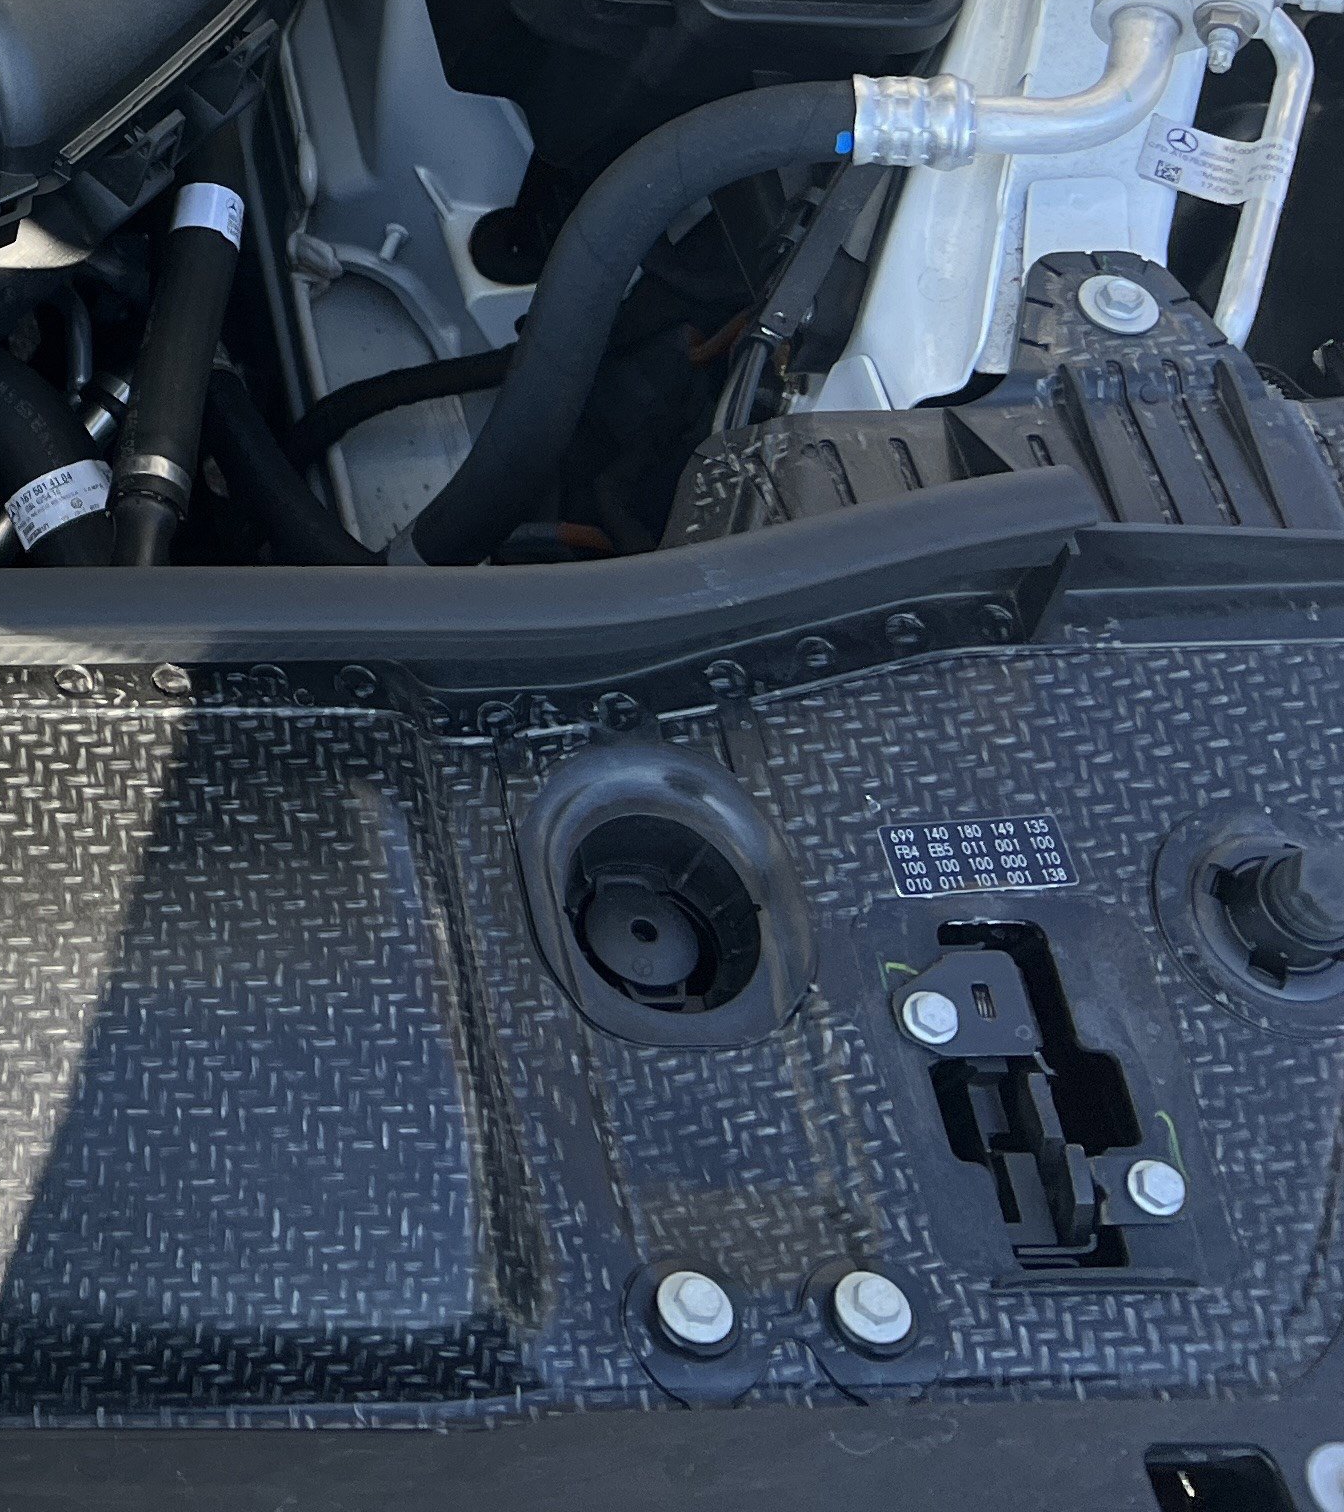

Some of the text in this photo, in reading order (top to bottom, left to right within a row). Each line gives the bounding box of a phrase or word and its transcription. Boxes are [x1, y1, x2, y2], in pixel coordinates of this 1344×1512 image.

[16, 500, 21, 508] A
[21, 491, 32, 505] 167
[50, 476, 61, 487] 41
[61, 471, 73, 484] 04
[890, 819, 1048, 843] 699 140 180 149 135
[895, 836, 1055, 860] FB4 EB5 011 001 100
[902, 852, 1061, 875] 100 100 100 000 110
[906, 868, 1067, 891] 010 011 101 001 138
